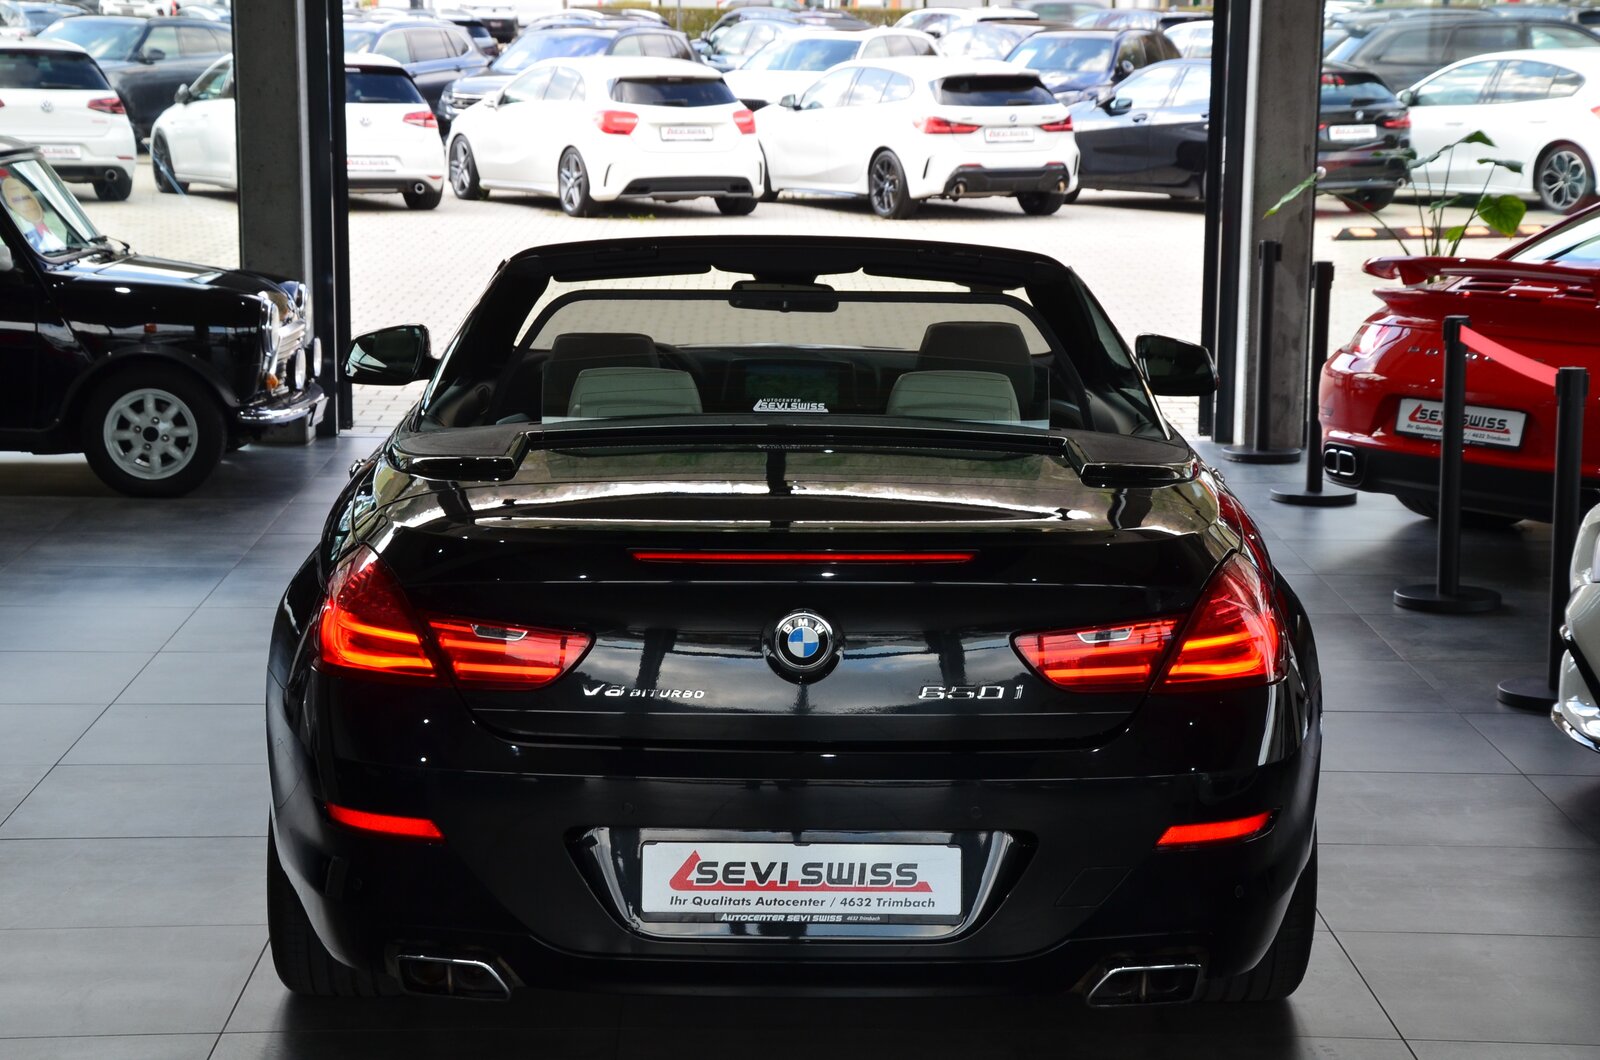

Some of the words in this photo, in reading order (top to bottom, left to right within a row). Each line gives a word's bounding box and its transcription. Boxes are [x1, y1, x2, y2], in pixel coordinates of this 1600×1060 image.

[790, 402, 825, 410] SWISS
[782, 618, 825, 635] BMW
[583, 683, 625, 697] V8
[630, 689, 705, 699] BITURBO
[695, 861, 789, 885] SEVI
[799, 862, 918, 886] SWISS
[669, 895, 688, 906] Ihr
[692, 896, 751, 907] Qualitats
[755, 896, 826, 907] Autocenter
[840, 897, 872, 907] 4632
[876, 897, 935, 908] Trimbach
[786, 914, 810, 922] SEVI
